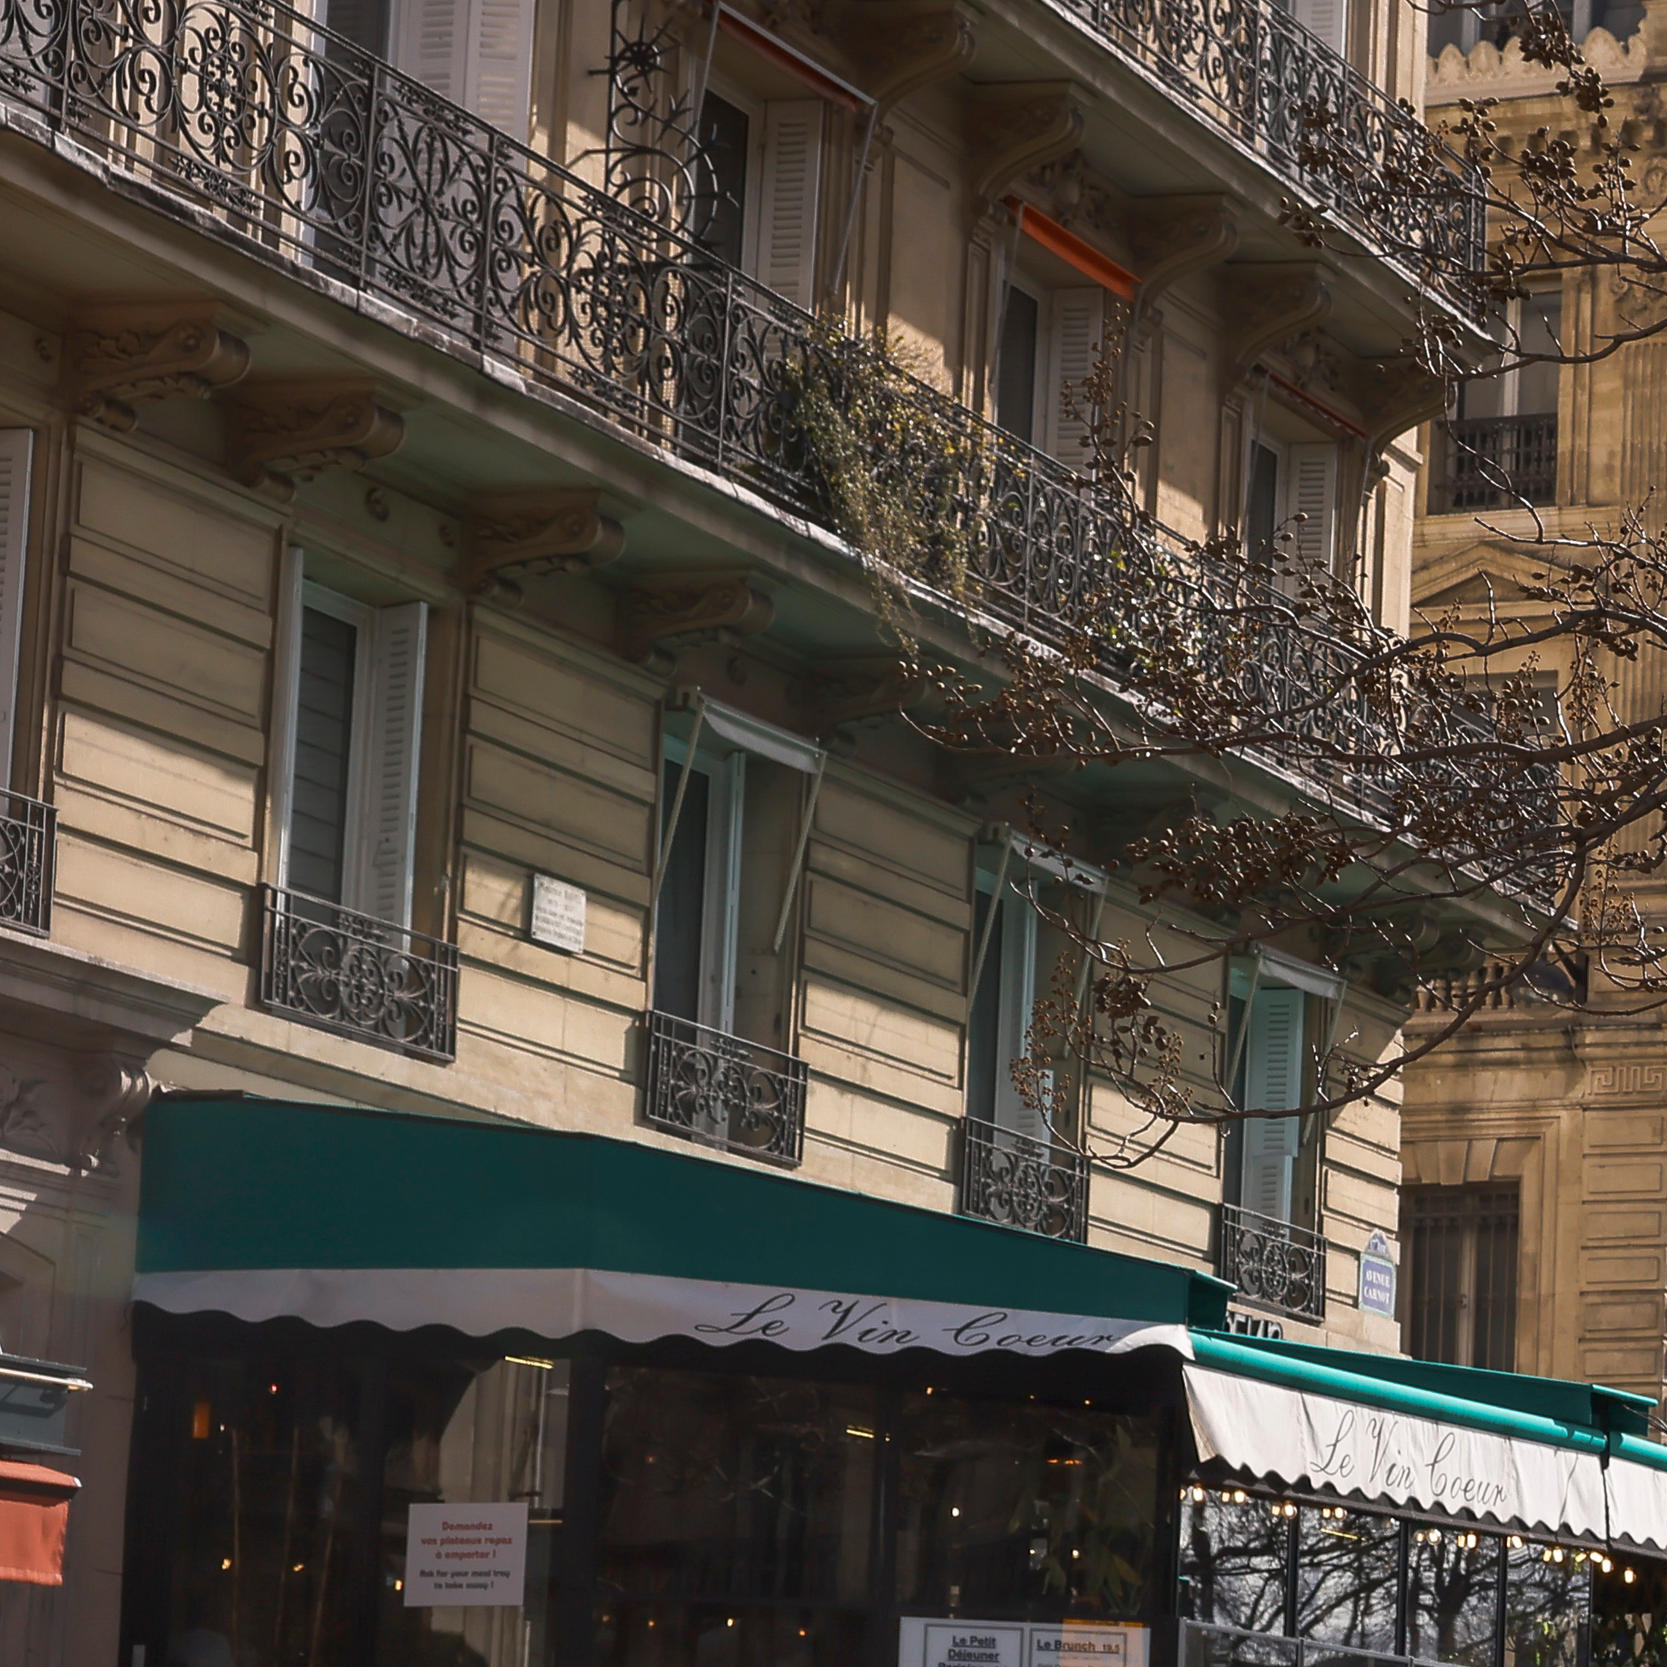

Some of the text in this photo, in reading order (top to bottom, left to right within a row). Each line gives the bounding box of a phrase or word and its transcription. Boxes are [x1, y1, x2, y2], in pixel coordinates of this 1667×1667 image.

[1365, 1269, 1390, 1289] AVENUE
[1363, 1287, 1390, 1304] CARNOT
[694, 1293, 1122, 1347] Le Vin Coeur
[1310, 1411, 1509, 1505] Le Vin Coeur
[442, 1521, 492, 1531] Demandez
[952, 1636, 996, 1648] Le Petit
[1037, 1639, 1052, 1651] Le
[1054, 1640, 1096, 1652] Brunch
